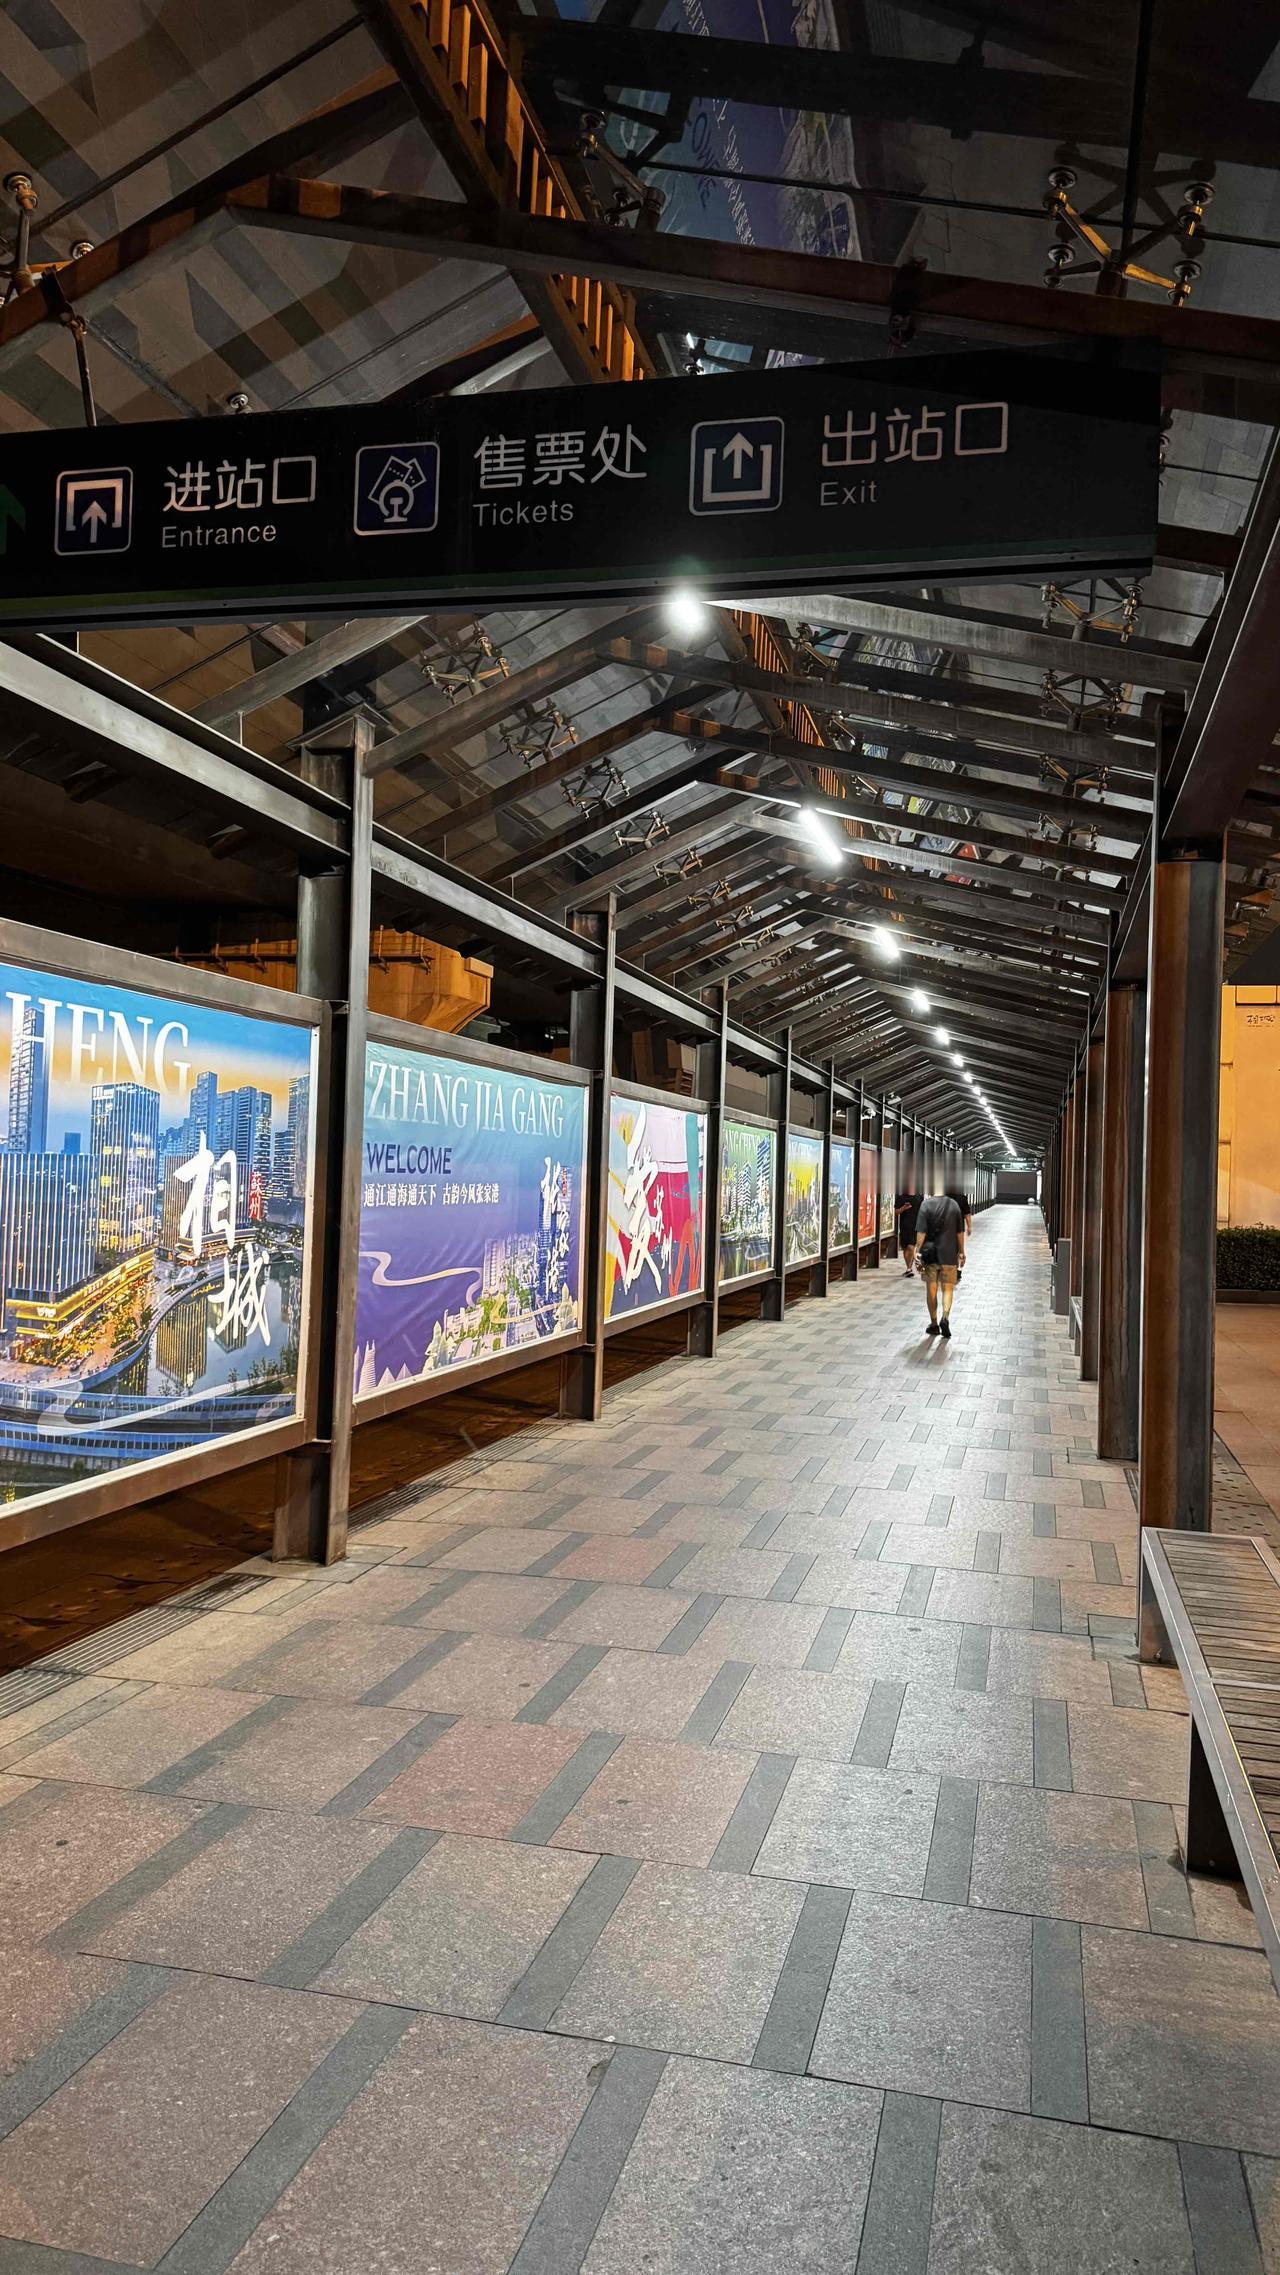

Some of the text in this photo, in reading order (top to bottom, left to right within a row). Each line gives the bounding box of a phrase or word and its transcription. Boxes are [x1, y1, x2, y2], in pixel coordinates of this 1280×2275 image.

[473, 423, 648, 490] 售票处
[821, 401, 1009, 467] 出站口
[162, 455, 317, 512] 进站口
[820, 479, 878, 506] Exit
[161, 523, 277, 549] Entrance
[472, 500, 574, 527] Tickets
[5, 991, 191, 1096] HENG
[366, 1060, 564, 1139] ZHANG JIA GANG
[366, 1142, 452, 1175] WELCOME
[363, 1182, 500, 1207] 通江通海通天下 古韵今风张家港
[173, 1129, 271, 1347] 相城
